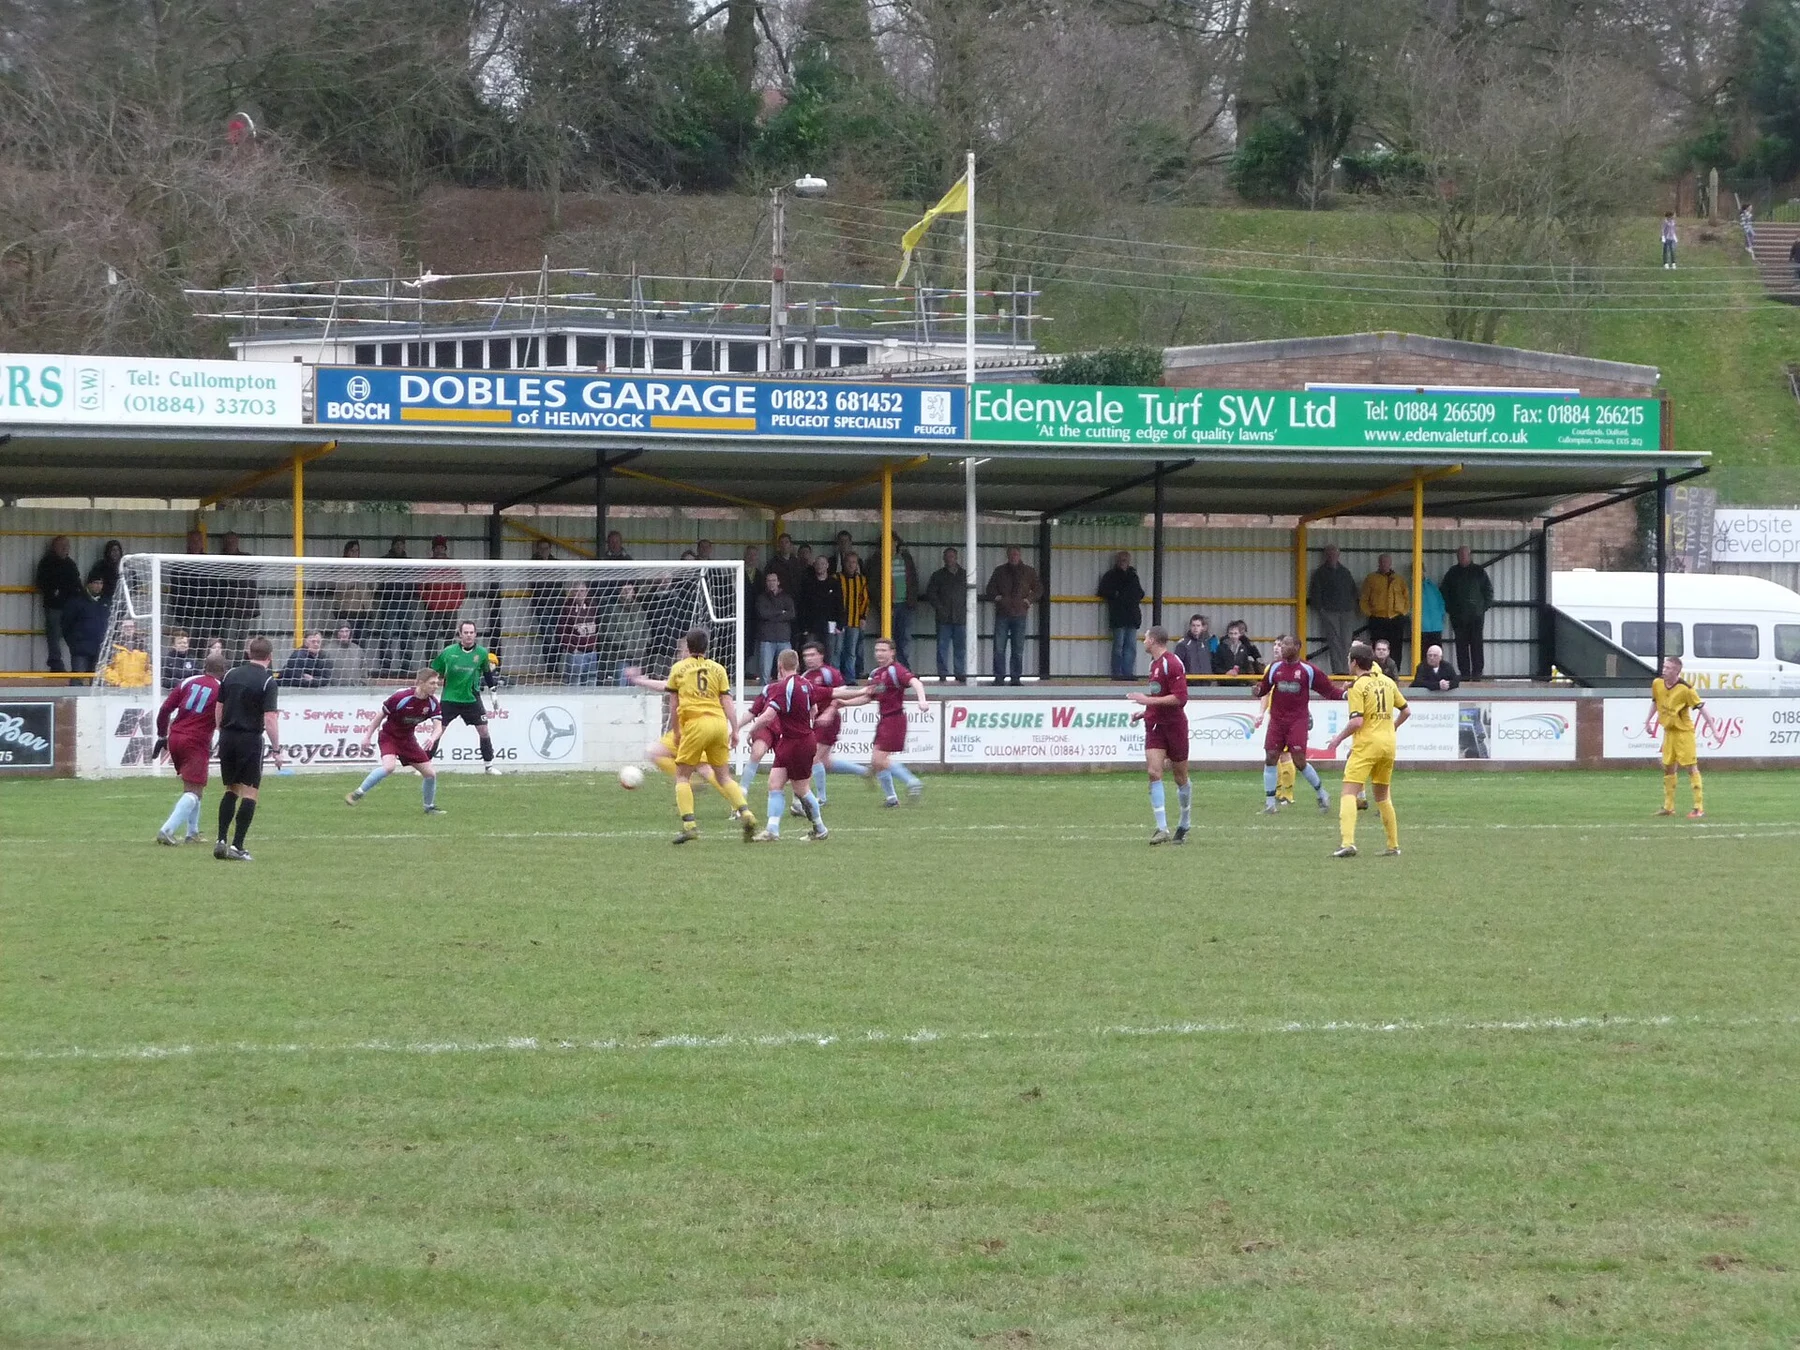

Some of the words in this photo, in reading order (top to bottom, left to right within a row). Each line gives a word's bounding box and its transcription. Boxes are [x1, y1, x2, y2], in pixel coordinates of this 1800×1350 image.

[0, 366, 64, 408] RS
[127, 369, 161, 387] Tel:
[169, 371, 277, 392] Cullompton
[401, 375, 567, 408] DOBLES
[581, 381, 756, 413] GARAGE
[771, 389, 828, 411] 01823
[835, 391, 903, 412] 681452
[123, 394, 205, 414] (01884)
[215, 397, 277, 416] 33703
[327, 402, 390, 420] BOSCH
[974, 388, 1124, 424] Edenvale
[1138, 392, 1202, 426] Turf
[1218, 394, 1275, 427] SW
[1289, 395, 1336, 428] Ltd
[1363, 400, 1389, 421] Tel:
[1394, 402, 1438, 422] 01884
[1443, 402, 1496, 423] 266509
[1512, 404, 1542, 424] Fax:
[1547, 404, 1590, 424] 01884
[1595, 406, 1644, 425] 266215
[517, 409, 539, 424] of
[544, 411, 644, 428] HEMYOCK
[771, 414, 830, 429] PEUGEOT
[834, 415, 902, 430] SPECIALIST
[913, 424, 957, 434] PEUGEOT
[1036, 423, 1054, 437] 'At
[1059, 424, 1081, 438] the
[1085, 425, 1131, 442] cutting
[1136, 426, 1168, 442] edge
[1173, 426, 1187, 440] of
[1191, 427, 1234, 443] quality
[1239, 428, 1278, 442] lawns'
[1363, 427, 1528, 444] www.edenvaleturf.co.uk
[1685, 486, 1700, 550] TIVERTO
[1712, 514, 1793, 534] website
[696, 667, 709, 692] 6
[184, 683, 212, 714] 11
[1374, 687, 1387, 712] 11
[303, 708, 344, 720] Service
[950, 706, 1045, 729] PRESSURE
[324, 723, 350, 734] New
[1498, 724, 1554, 745] bespoke
[951, 735, 981, 744] Nilfisk
[1119, 735, 1145, 743] Nilfis
[951, 744, 975, 753] ALTO
[1127, 744, 1145, 752] ALT
[452, 747, 518, 760] 82946
[984, 745, 1046, 757] CULLOMPTON
[1050, 745, 1085, 757] (01884)
[1088, 745, 1118, 756] 33703
